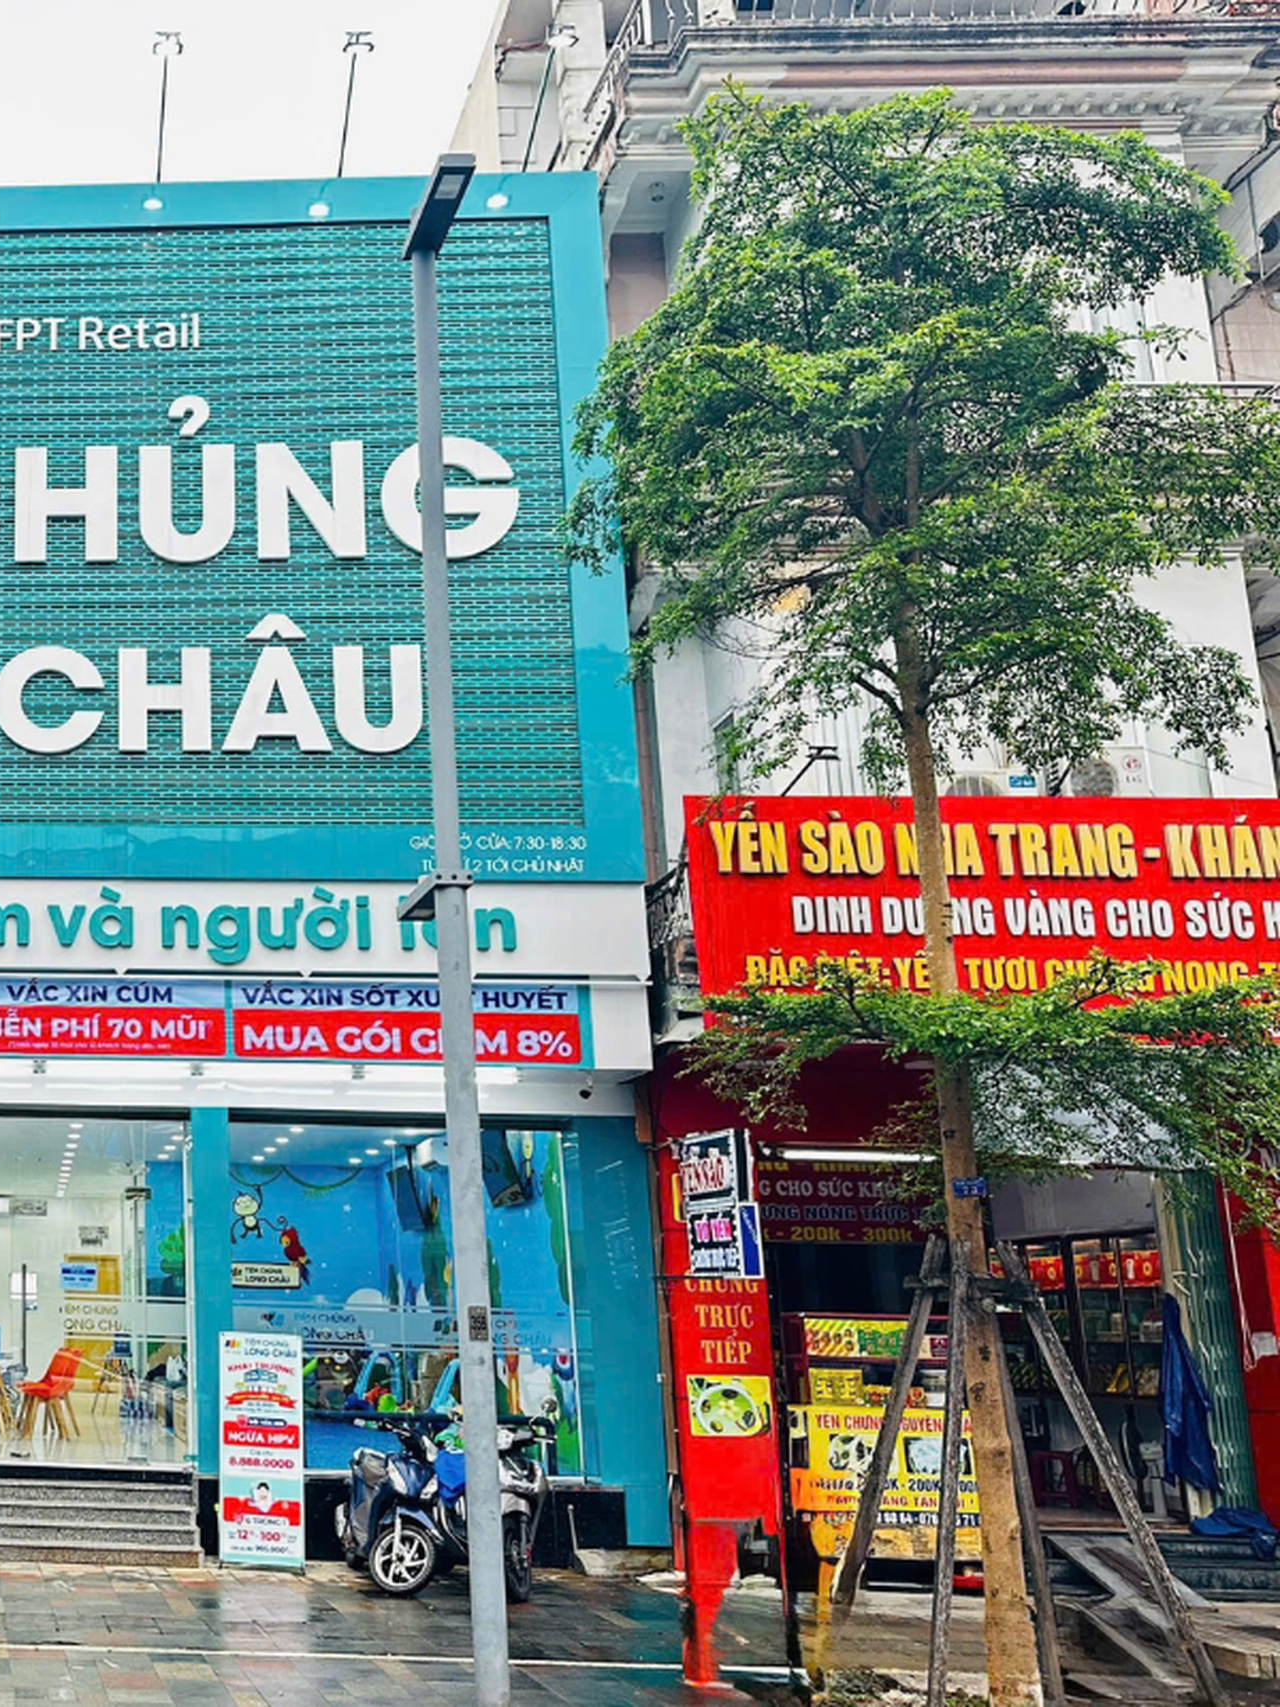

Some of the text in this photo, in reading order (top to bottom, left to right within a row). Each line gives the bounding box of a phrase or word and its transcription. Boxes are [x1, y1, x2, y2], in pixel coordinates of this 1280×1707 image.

[78, 314, 201, 351] Retail
[800, 810, 885, 876] SÀO
[988, 823, 1138, 879] TRANG
[47, 886, 134, 949] và
[161, 886, 370, 966] người
[792, 896, 873, 934] DINH
[1004, 888, 1096, 937] VÀNG
[1106, 899, 1175, 939] CHO
[1184, 891, 1256, 940] SỨC
[66, 985, 108, 1003] XIN
[115, 980, 174, 1004] CÚM
[302, 987, 343, 1007] XIN
[351, 983, 401, 1008] SỐT
[482, 985, 568, 1011] HUYẾT
[51, 1013, 102, 1039] PHÍ
[107, 1018, 143, 1039] 70
[243, 1020, 572, 1057] MUA GÓI GIM 8%
[775, 1180, 813, 1197] CHO
[817, 1176, 854, 1198] SỨC
[790, 1226, 841, 1242] 200k
